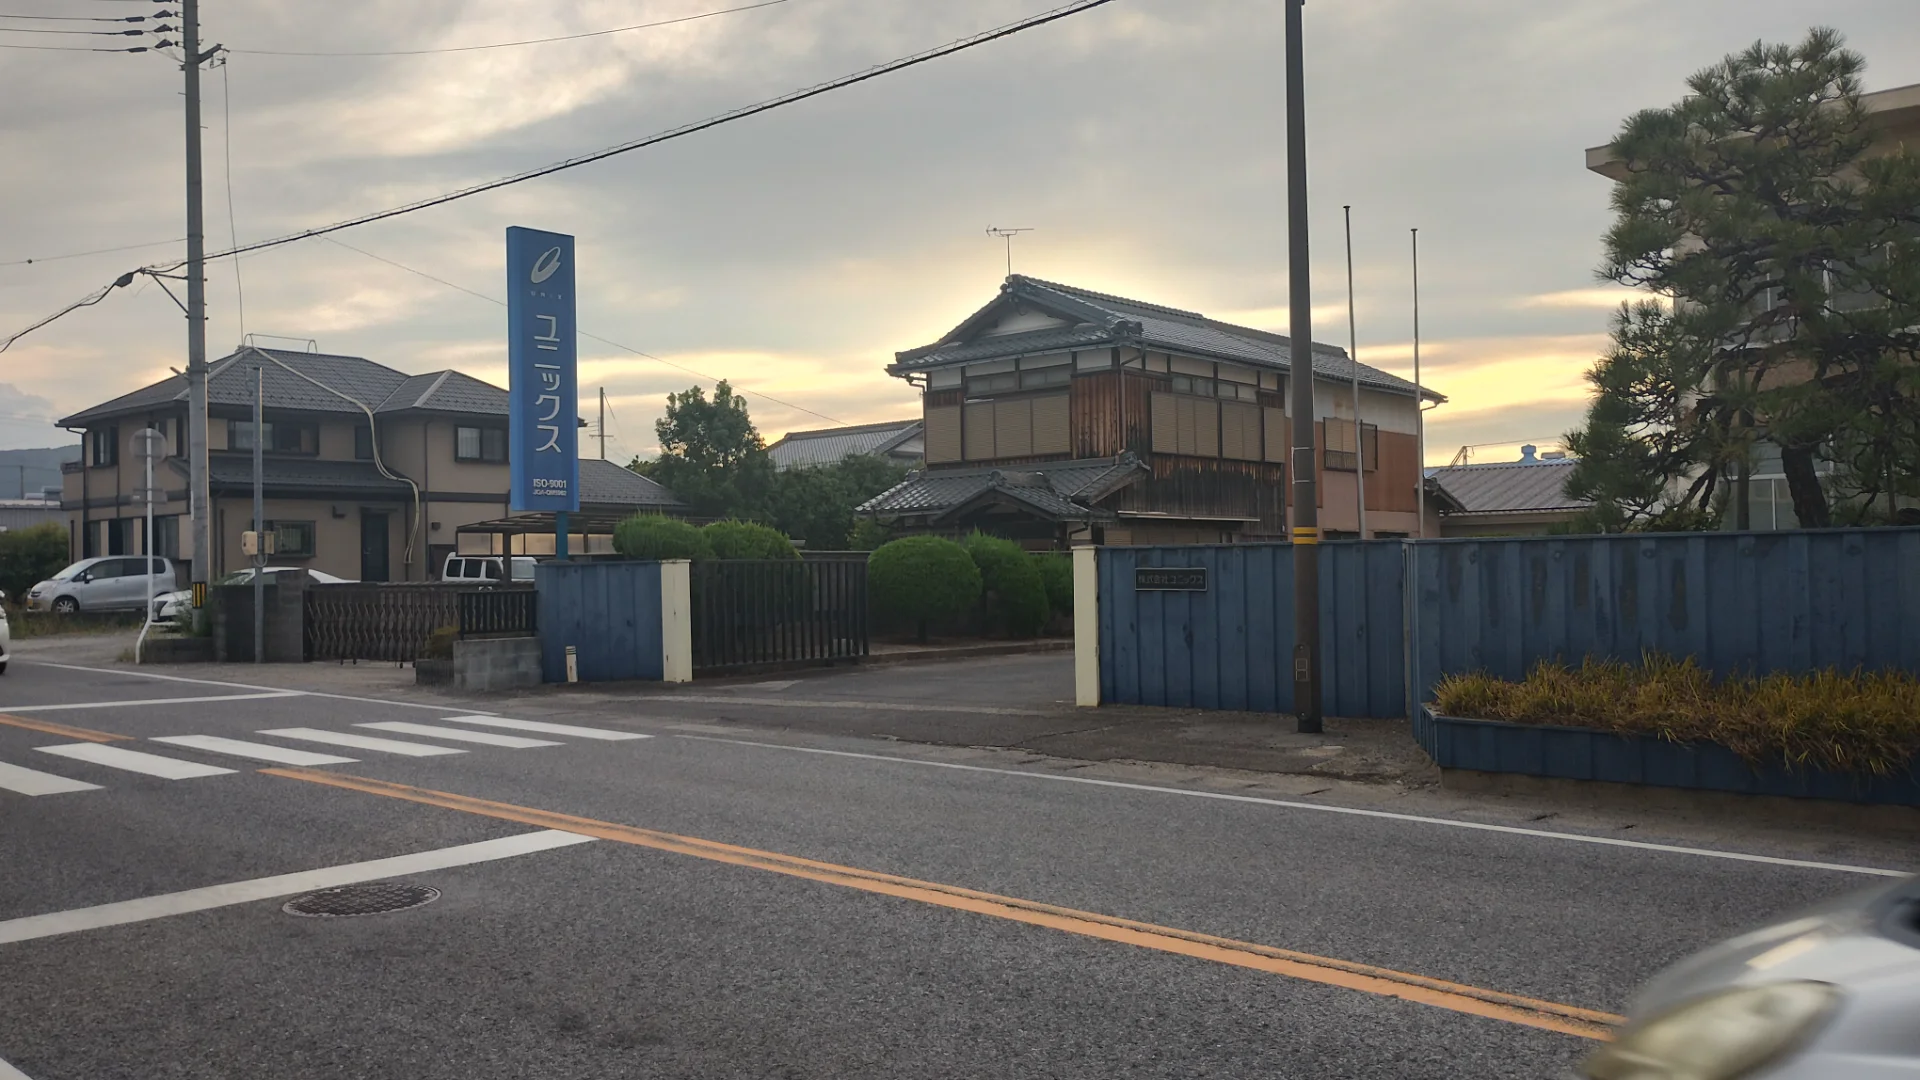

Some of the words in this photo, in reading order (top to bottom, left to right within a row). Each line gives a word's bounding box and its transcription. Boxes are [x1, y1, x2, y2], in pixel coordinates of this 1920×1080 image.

[533, 314, 562, 453] ユニックス
[533, 478, 567, 489] ISO-9001
